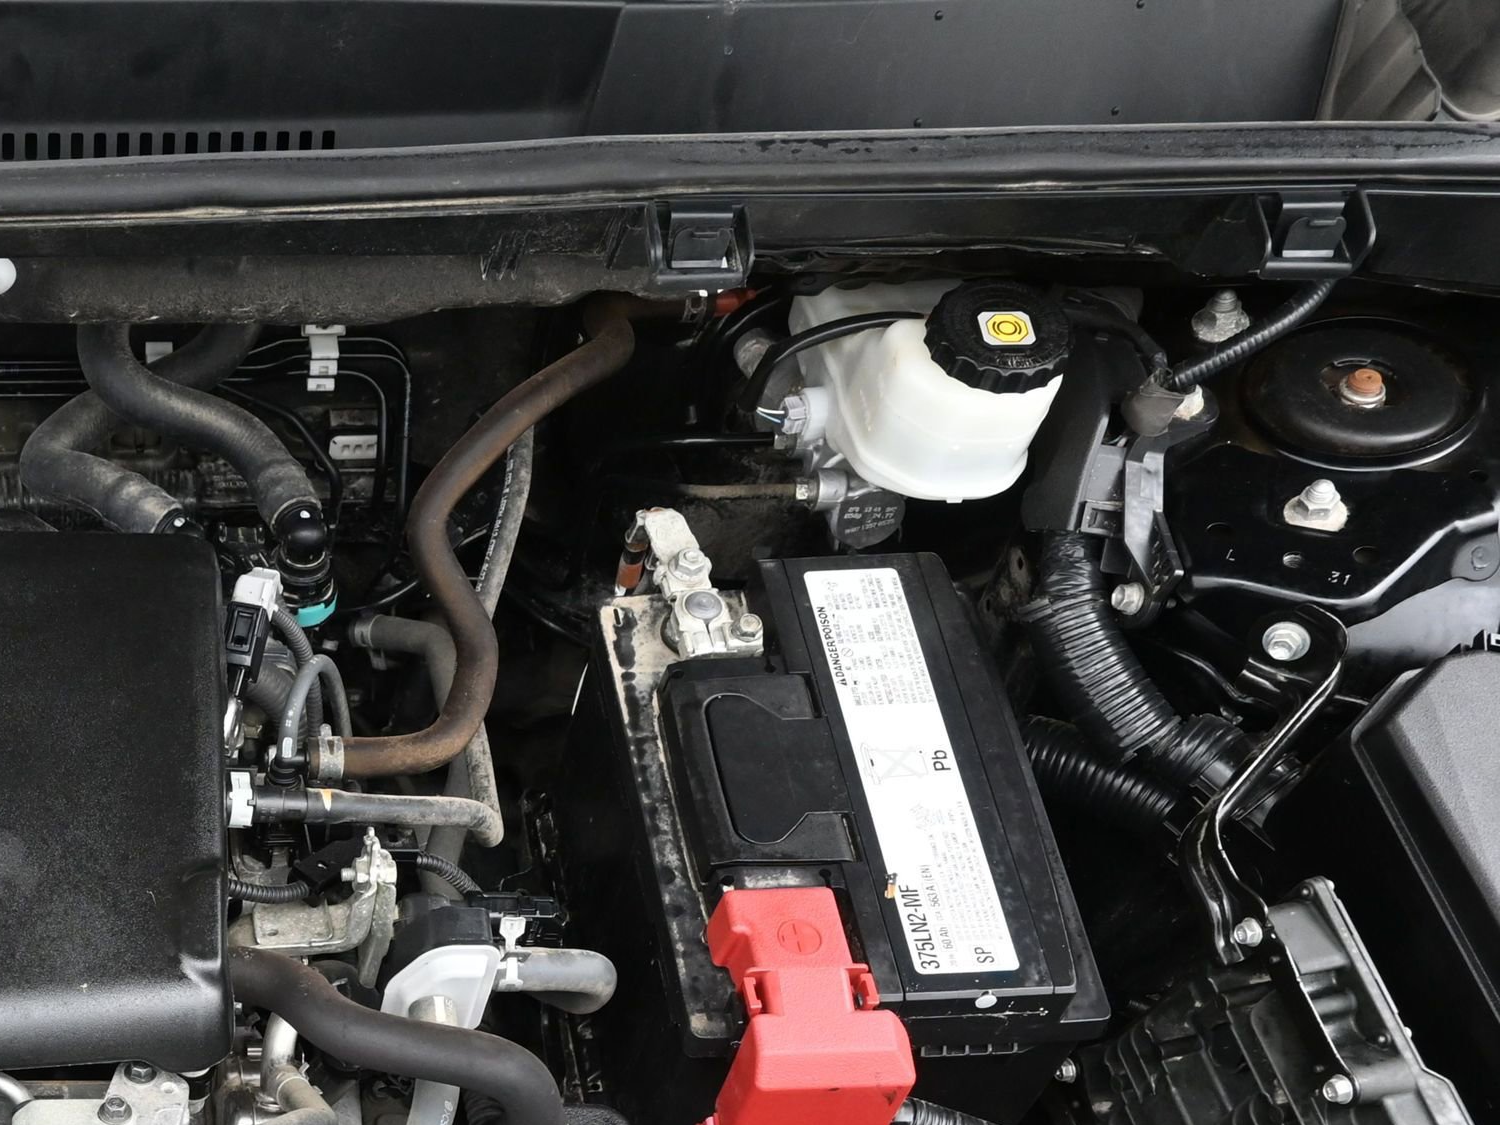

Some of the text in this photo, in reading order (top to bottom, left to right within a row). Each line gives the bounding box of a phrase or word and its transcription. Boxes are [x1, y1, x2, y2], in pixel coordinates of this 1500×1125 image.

[816, 606, 845, 678] DANGER POISON
[932, 750, 951, 771] Pb
[898, 885, 940, 969] 375LN2-MF
[974, 947, 995, 964] SP
